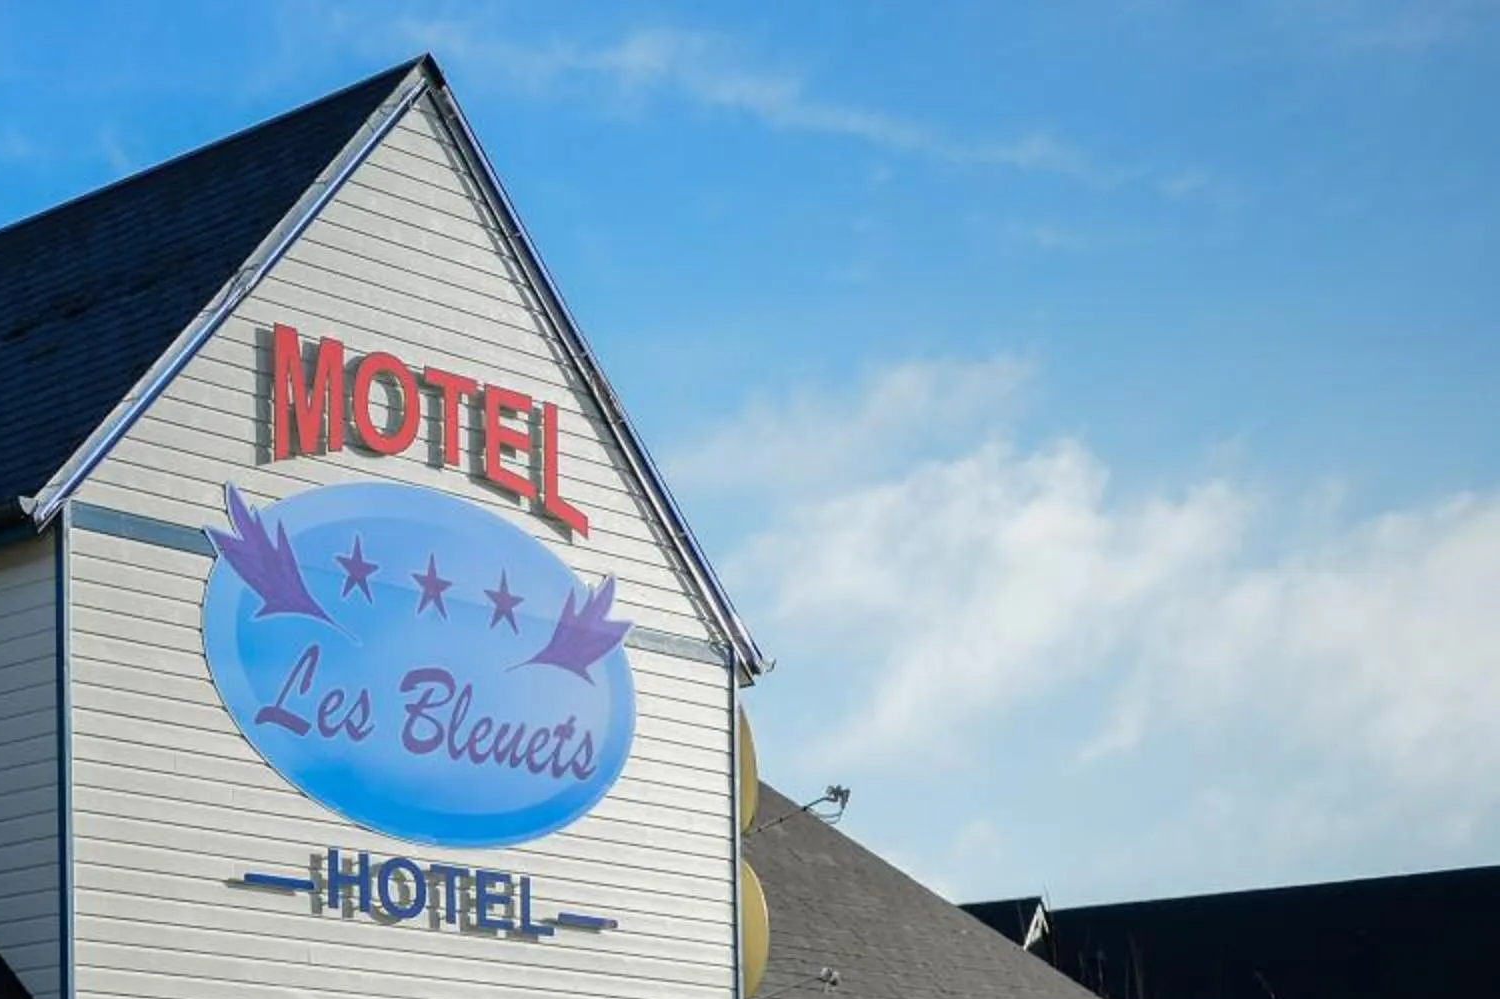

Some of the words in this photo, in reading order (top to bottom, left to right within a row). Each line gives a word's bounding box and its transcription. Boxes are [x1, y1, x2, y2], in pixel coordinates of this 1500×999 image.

[274, 322, 589, 540] MOTEL
[255, 644, 373, 742] Les
[399, 668, 597, 780] Bleuets
[327, 847, 554, 937] HOTEL
